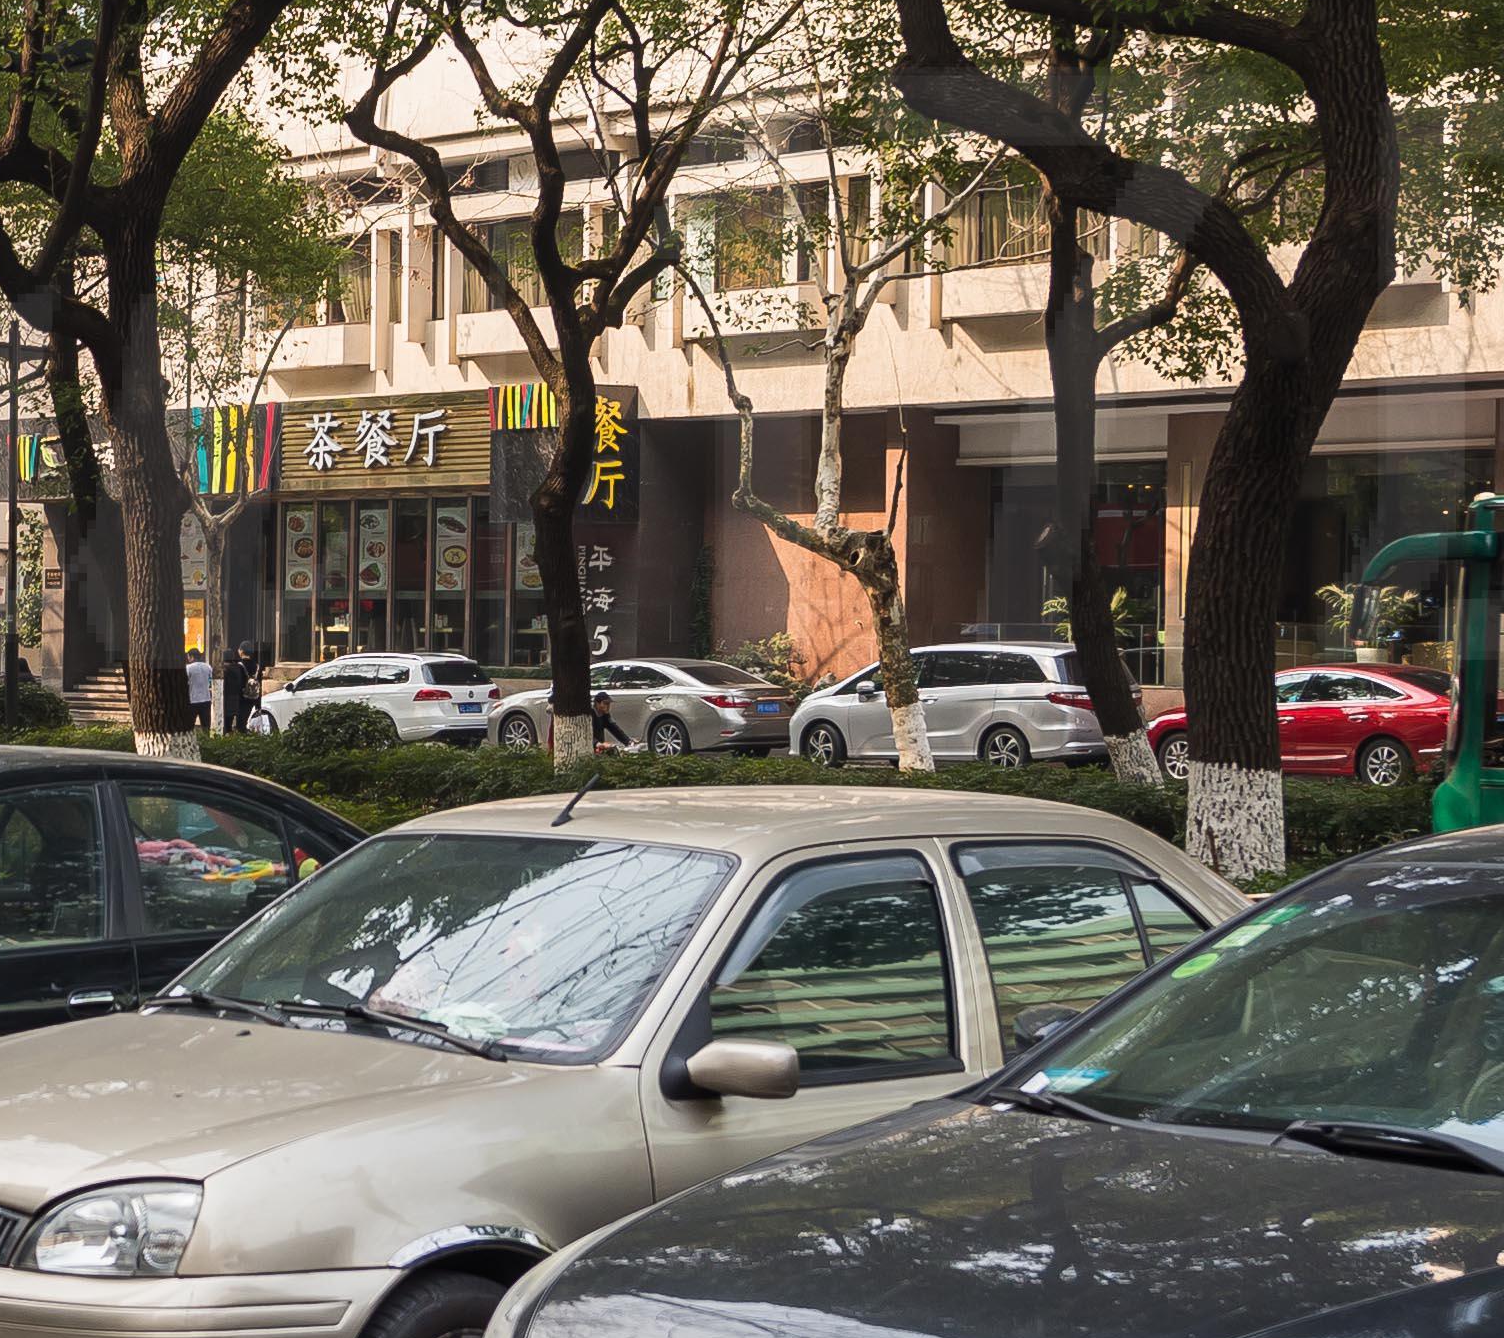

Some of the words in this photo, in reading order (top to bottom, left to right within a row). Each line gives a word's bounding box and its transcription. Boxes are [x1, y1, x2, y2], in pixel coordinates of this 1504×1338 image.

[303, 409, 448, 471] 茶餐厅
[582, 394, 628, 510] 餐厅
